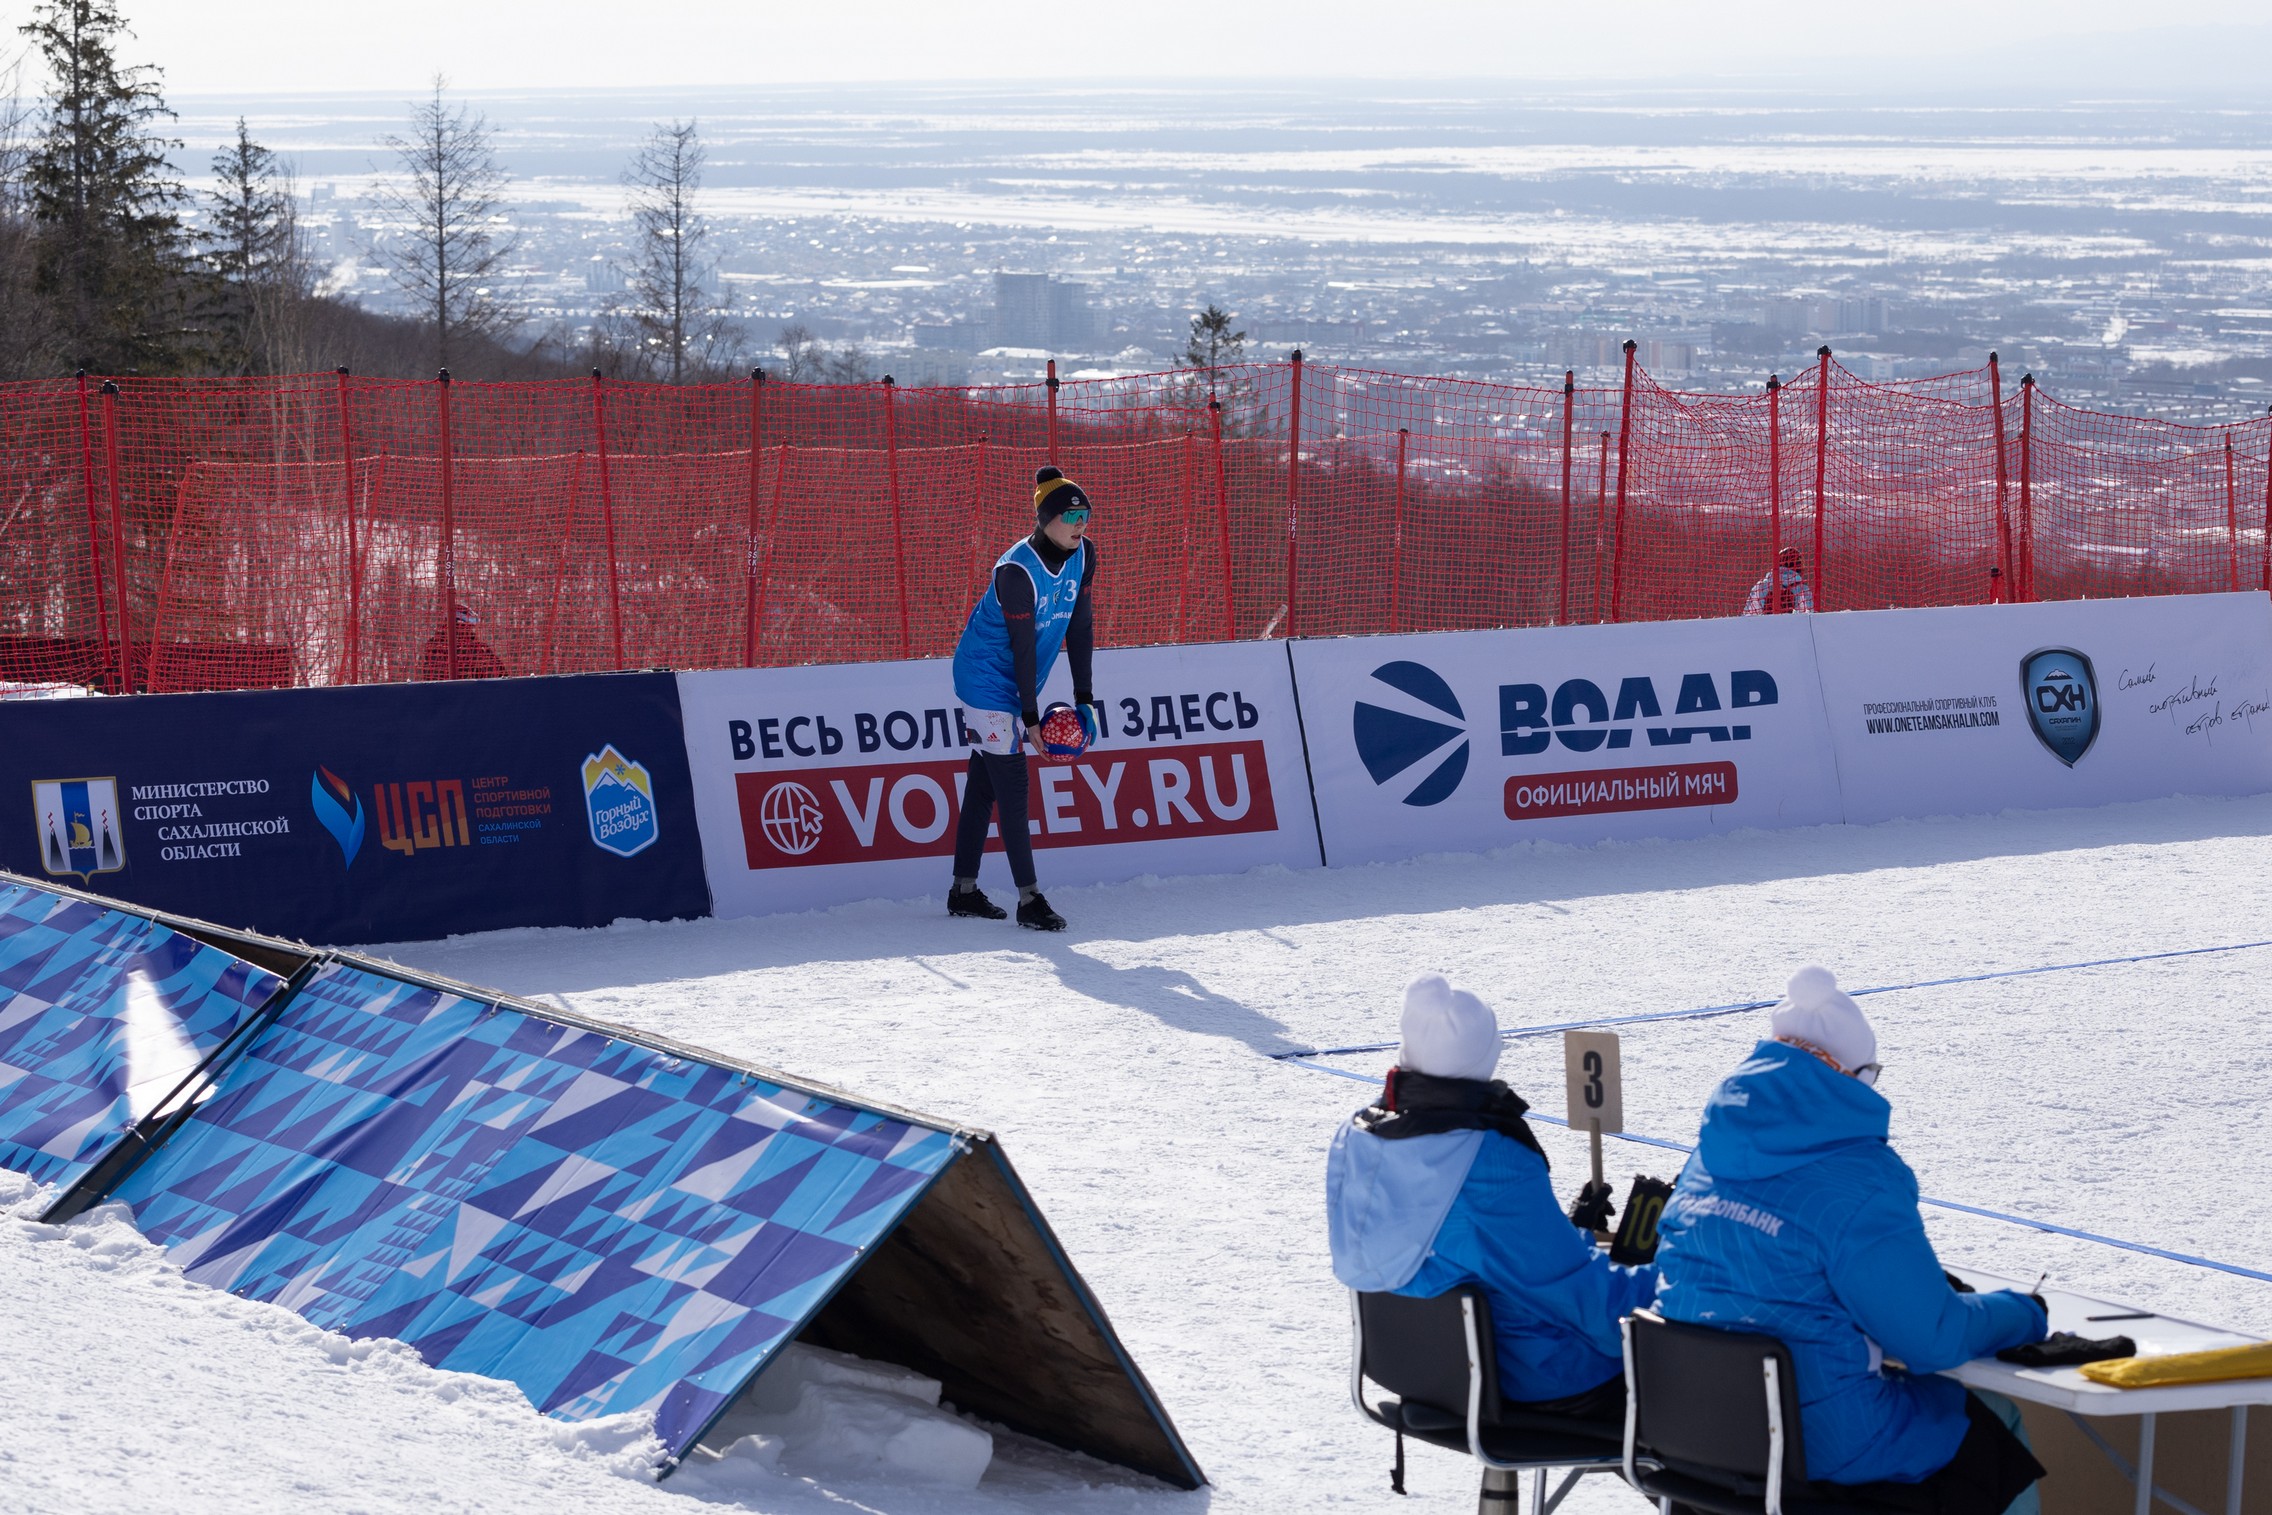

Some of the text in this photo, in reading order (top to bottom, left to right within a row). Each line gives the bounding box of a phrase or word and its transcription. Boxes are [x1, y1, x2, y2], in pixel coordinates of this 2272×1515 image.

[1063, 579, 1077, 602] 3
[2118, 662, 2156, 691] Самый
[1863, 695, 1997, 715] ПРОФЕССИОНАЛЬНЫЙ СПОРТИВНЫЙ КЛУБ
[728, 716, 844, 760] ВЕСЬ
[1119, 691, 1259, 742] ЗДЕСЬ
[1866, 711, 2000, 735] WWW.ONETEAMSAKHALIN.COM
[131, 779, 270, 800] МИНИСТЕРСТВО
[472, 776, 509, 789] ЦЕНТР
[1516, 771, 1726, 808] ОФИЦИАЛЬНЫЙ МЯЧ
[474, 787, 551, 803] СПОРТИВНОЙ
[830, 753, 1252, 848] VOEY.RU
[134, 804, 203, 820] СПОРТА
[373, 779, 471, 856] ЦСП
[476, 804, 552, 818] ПОДГОТОВКИ
[595, 795, 642, 825] Горный
[158, 816, 290, 840] САХАЛИНСКОЙ
[478, 819, 542, 832] САХАЛИНСКОЙ
[600, 810, 649, 840] Воздух
[160, 842, 241, 861] ОБЛАСТИ
[480, 835, 520, 845] ОБЛАСТИ
[1583, 1050, 1604, 1109] 3
[1623, 1193, 1664, 1251] 10
